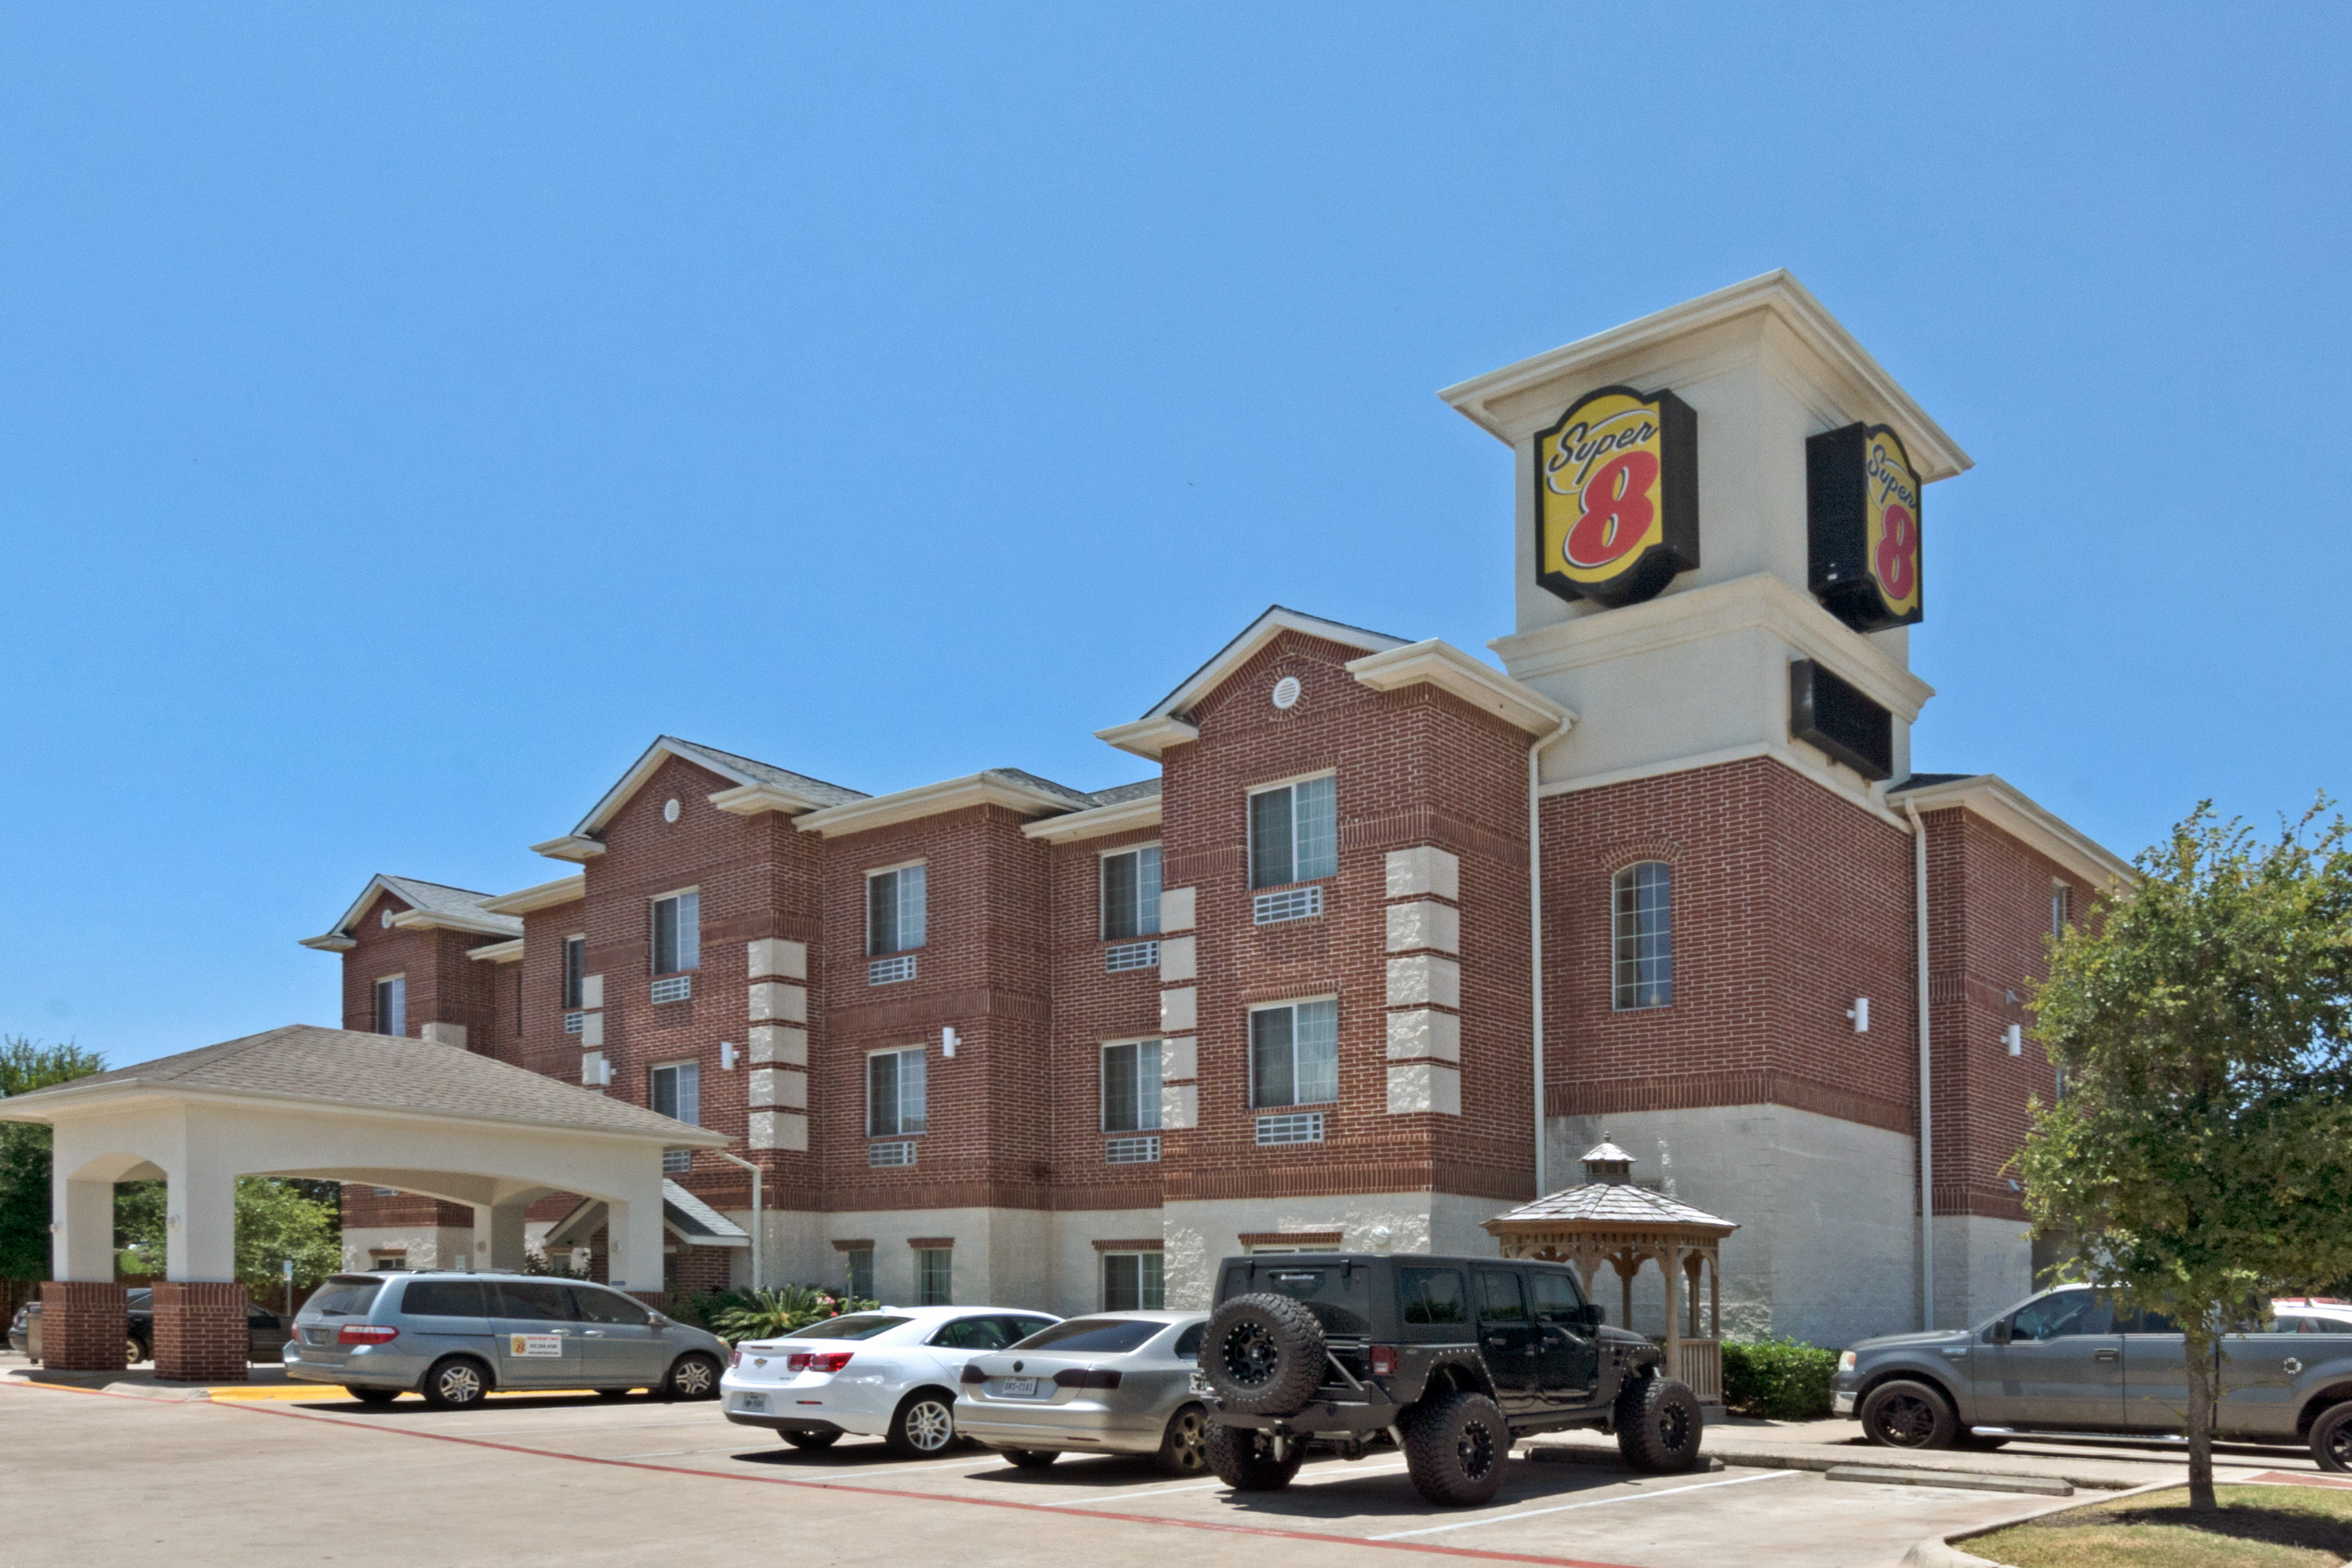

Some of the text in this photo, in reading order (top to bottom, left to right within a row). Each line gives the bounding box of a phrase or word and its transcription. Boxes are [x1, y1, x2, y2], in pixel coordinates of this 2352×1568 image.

[1545, 421, 1659, 487] Super
[1867, 443, 1915, 509] Super
[1563, 450, 1660, 568] 8
[1875, 503, 1918, 600] 8
